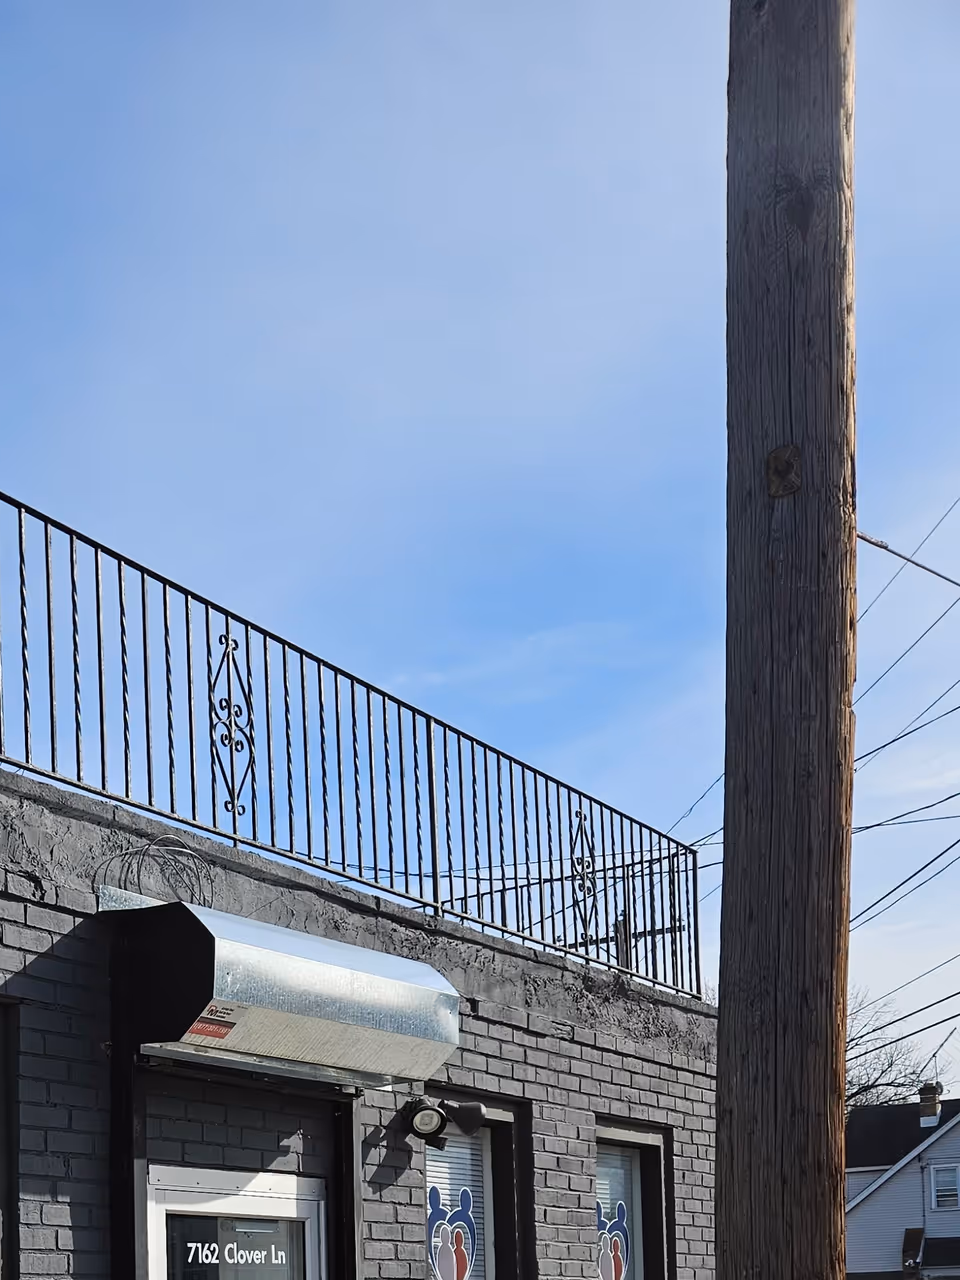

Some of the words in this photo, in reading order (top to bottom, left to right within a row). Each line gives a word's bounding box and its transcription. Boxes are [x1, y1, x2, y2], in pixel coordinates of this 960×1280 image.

[187, 1243, 220, 1264] 7162
[224, 1242, 267, 1264] Clover
[271, 1244, 286, 1264] Ln
